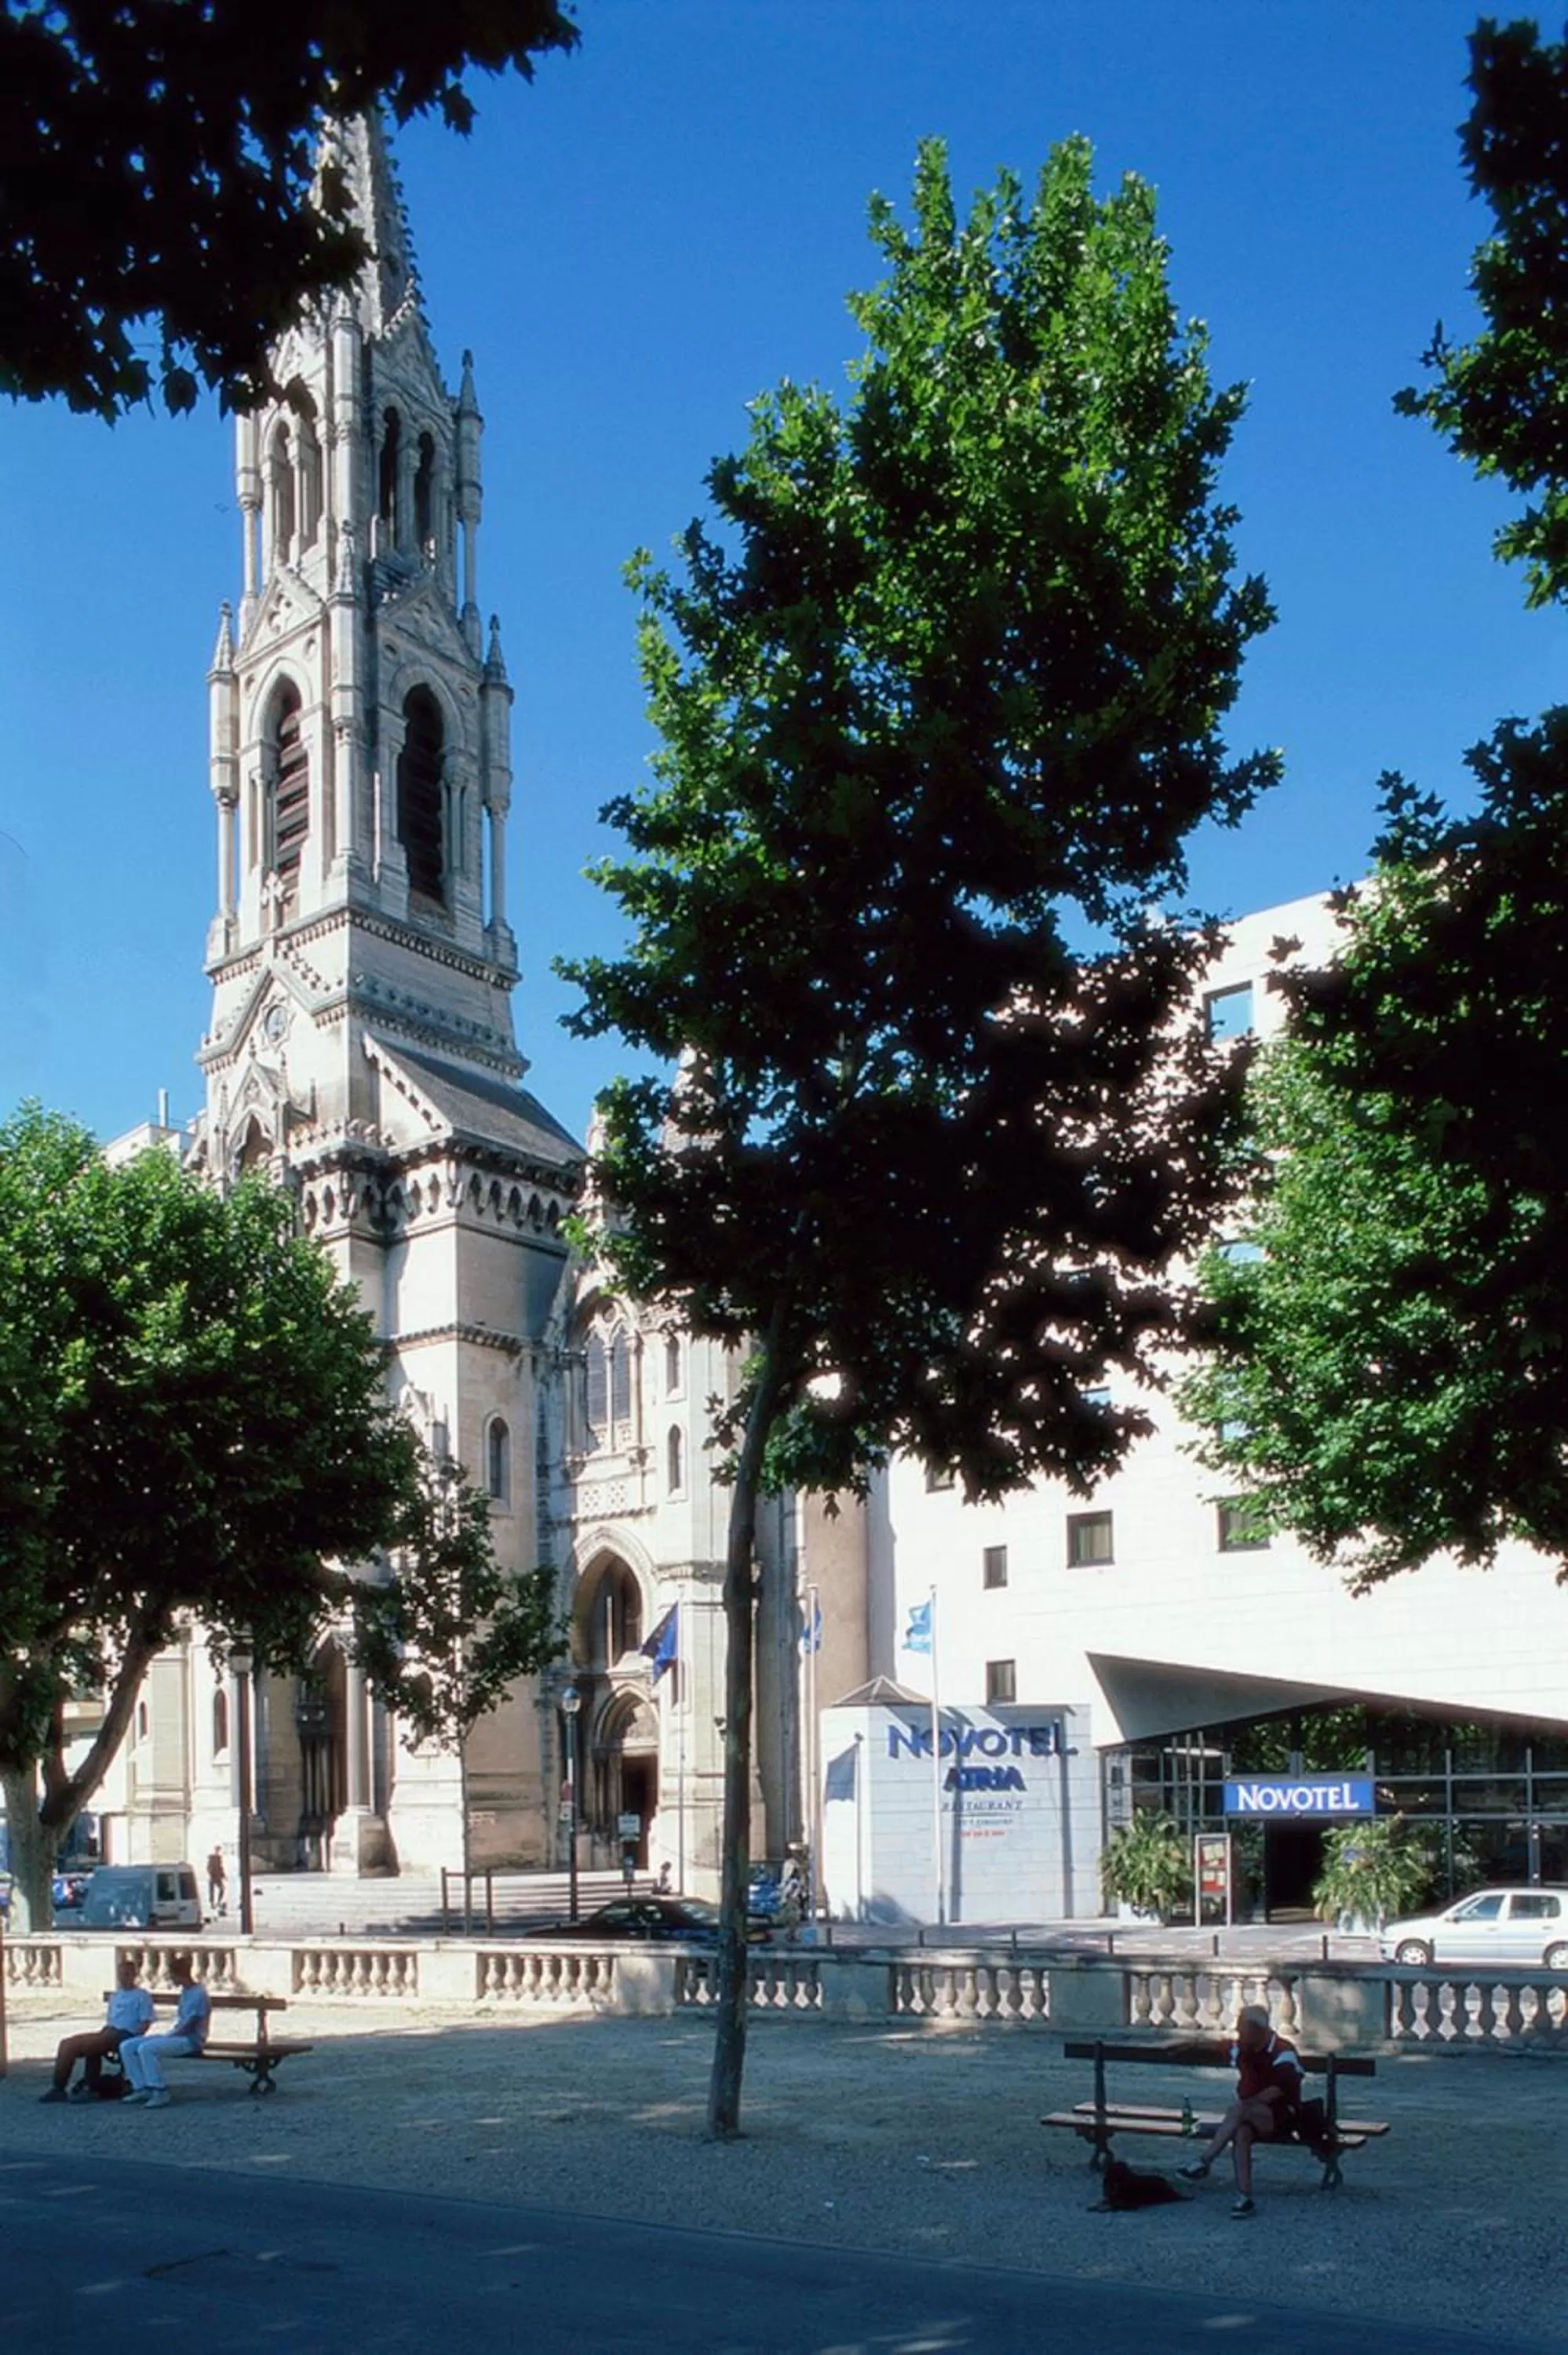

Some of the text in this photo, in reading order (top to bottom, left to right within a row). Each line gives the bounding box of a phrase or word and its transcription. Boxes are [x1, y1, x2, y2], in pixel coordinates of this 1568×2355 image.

[888, 1722, 1078, 1758] NOVOTEL
[943, 1766, 1026, 1791] ATRIA
[941, 1800, 1023, 1812] RTAURANT
[1237, 1783, 1359, 1811] NOVOTEL
